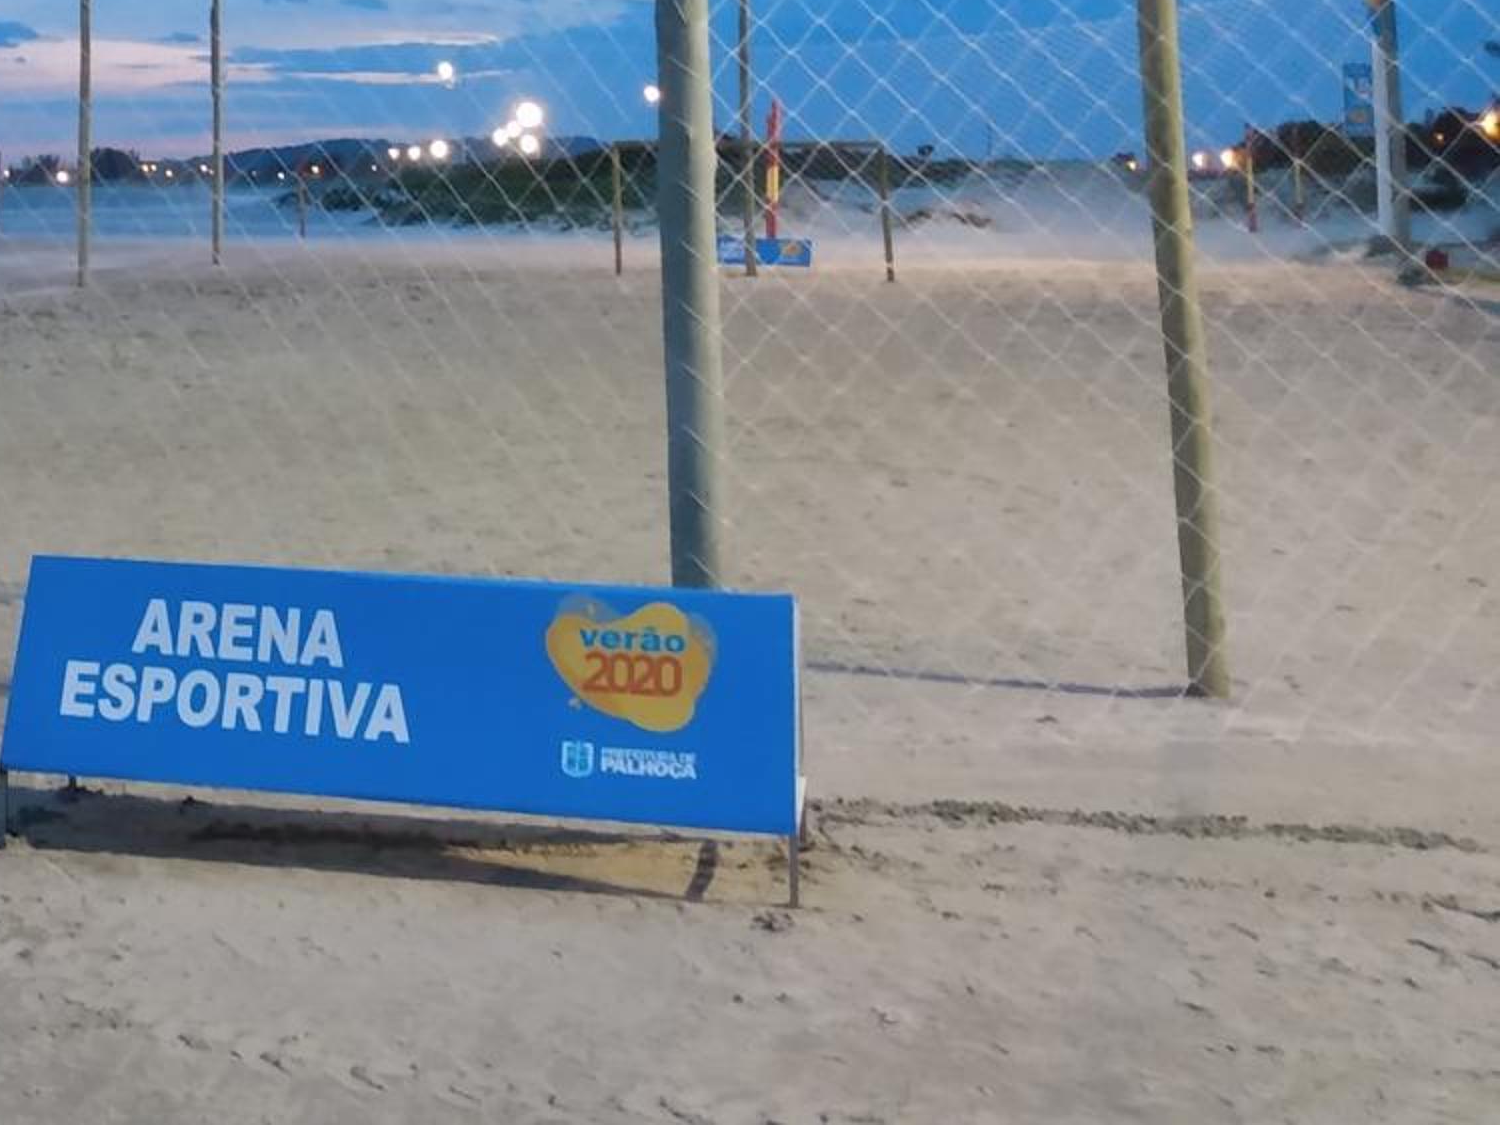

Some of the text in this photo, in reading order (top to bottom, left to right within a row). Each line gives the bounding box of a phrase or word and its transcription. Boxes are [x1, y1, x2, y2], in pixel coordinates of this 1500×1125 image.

[132, 598, 344, 668] ARENA
[580, 626, 687, 653] verão
[60, 660, 410, 744] ESPORTIVA
[582, 650, 684, 698] 2020
